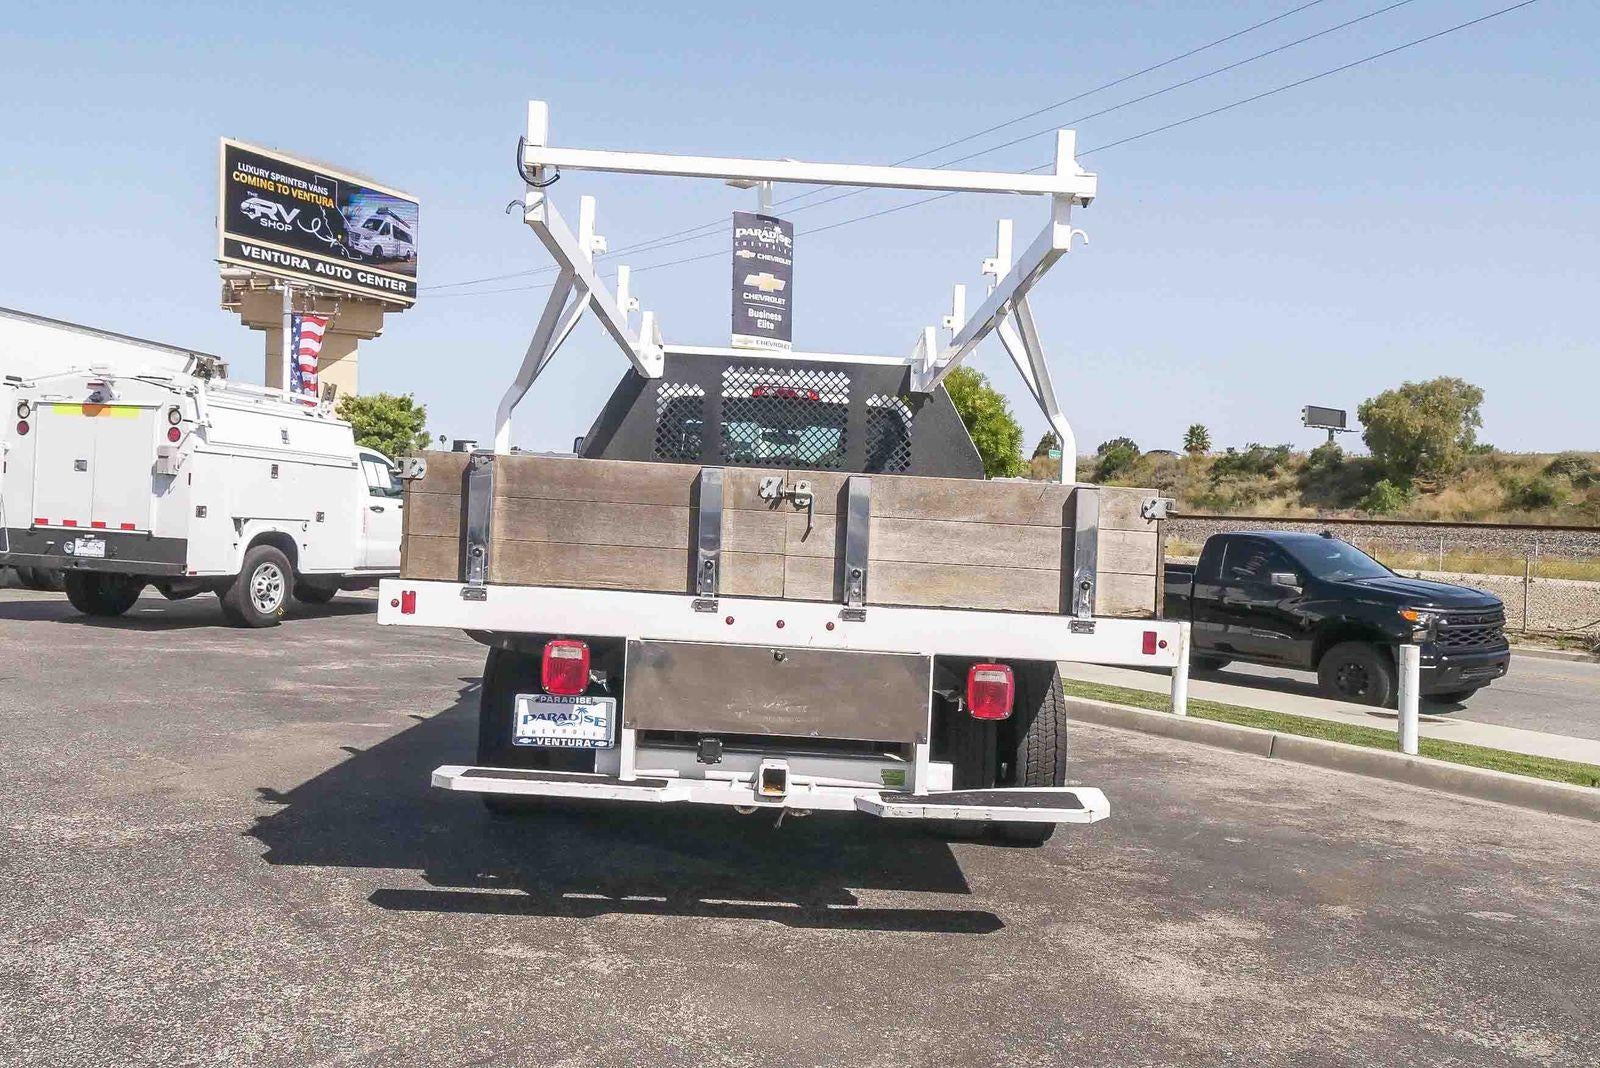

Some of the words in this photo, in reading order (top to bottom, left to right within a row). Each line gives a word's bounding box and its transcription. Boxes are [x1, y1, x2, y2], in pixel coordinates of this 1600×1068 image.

[237, 162, 270, 179] LUXURY
[270, 172, 308, 189] SPRINTER
[308, 183, 329, 195] VANS
[232, 171, 275, 192] COMING
[276, 183, 290, 195] TO
[291, 187, 335, 208] VENTURA
[244, 197, 301, 224] RV
[260, 218, 293, 232] SHOP
[757, 253, 792, 266] CHEVROLET
[241, 244, 311, 270] VENTURA
[315, 262, 352, 280] AUTO
[357, 272, 407, 292] CENTER
[743, 292, 786, 305] CHEVROLET
[748, 307, 782, 321] Business
[757, 319, 775, 330] Elite
[540, 696, 593, 705] PARADISE
[522, 707, 607, 728] PARADISE
[536, 737, 593, 747] VENTURA
